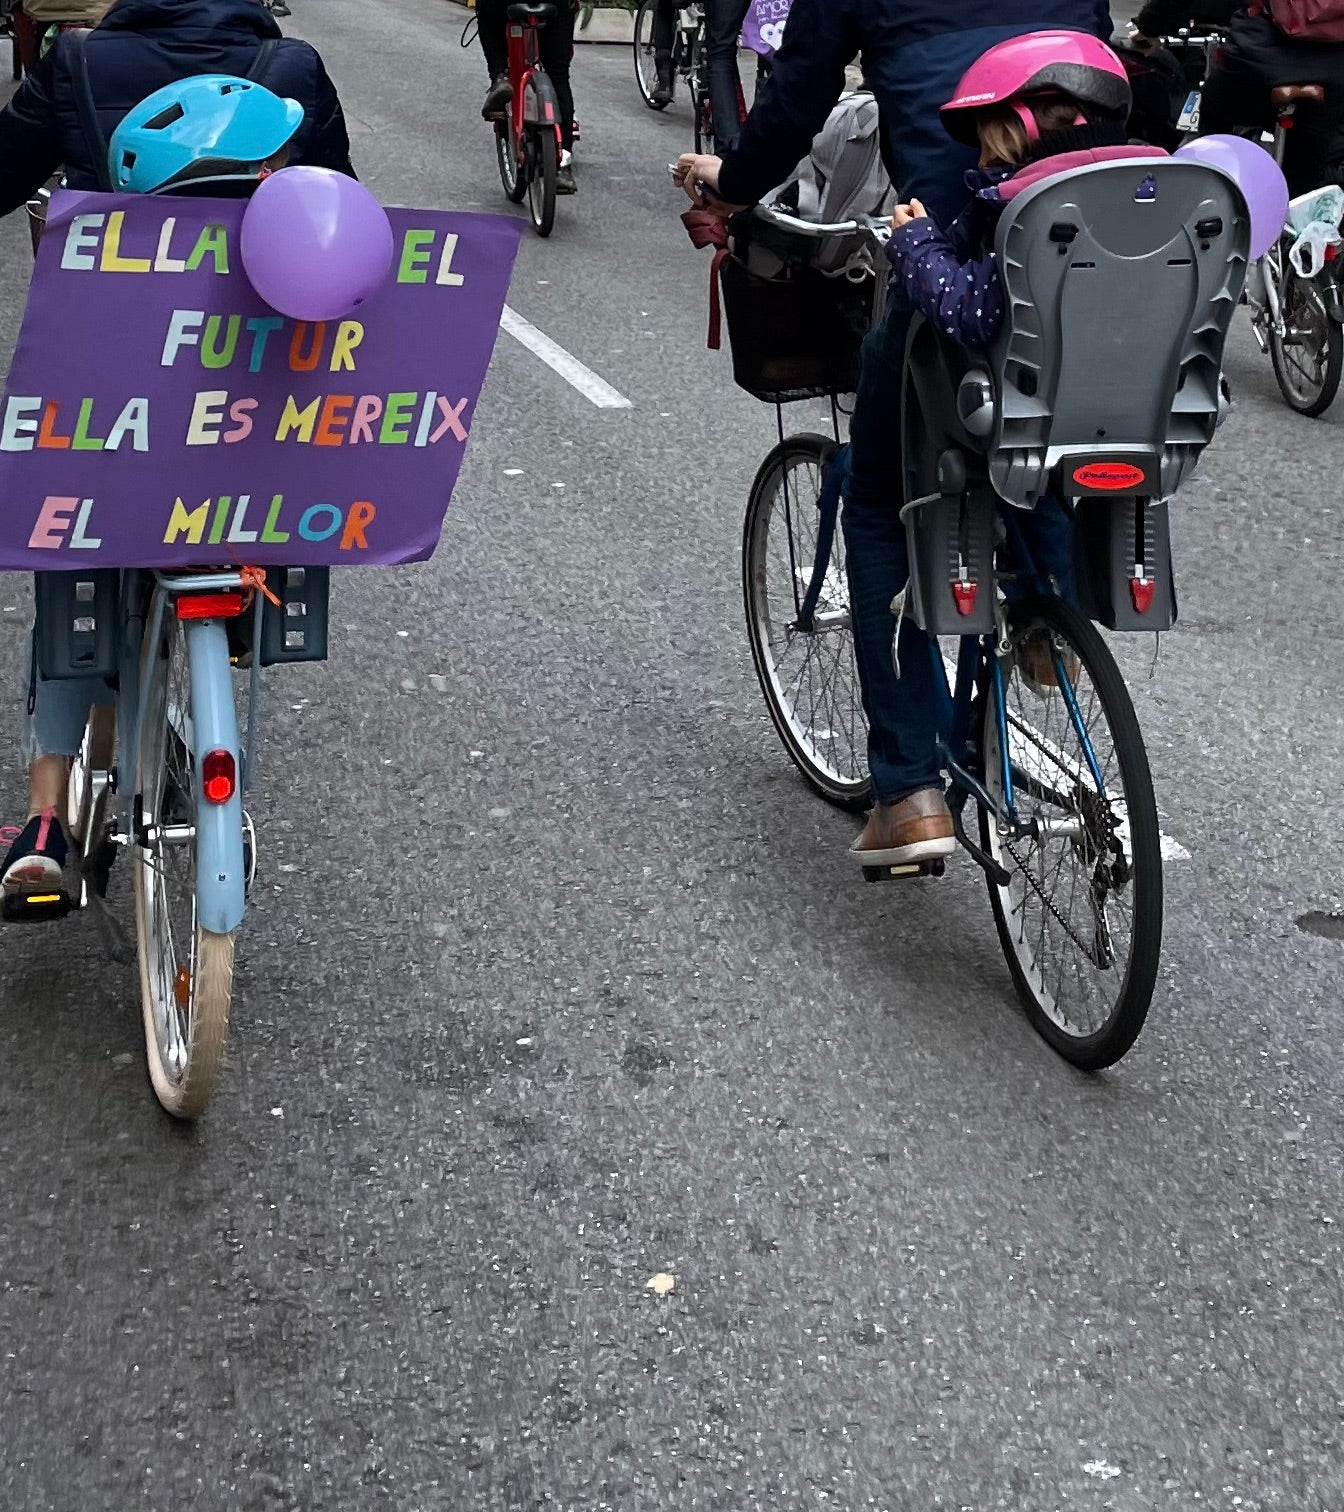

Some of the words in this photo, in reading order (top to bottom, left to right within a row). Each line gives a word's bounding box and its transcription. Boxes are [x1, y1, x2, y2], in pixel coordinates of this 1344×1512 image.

[60, 210, 231, 275] ELLA
[396, 229, 465, 287] EL
[160, 309, 365, 373] FUTUR
[0, 395, 150, 452] ELLA
[274, 391, 470, 445] MEREIX
[28, 495, 102, 550] EL
[163, 494, 377, 551] MILLOR
